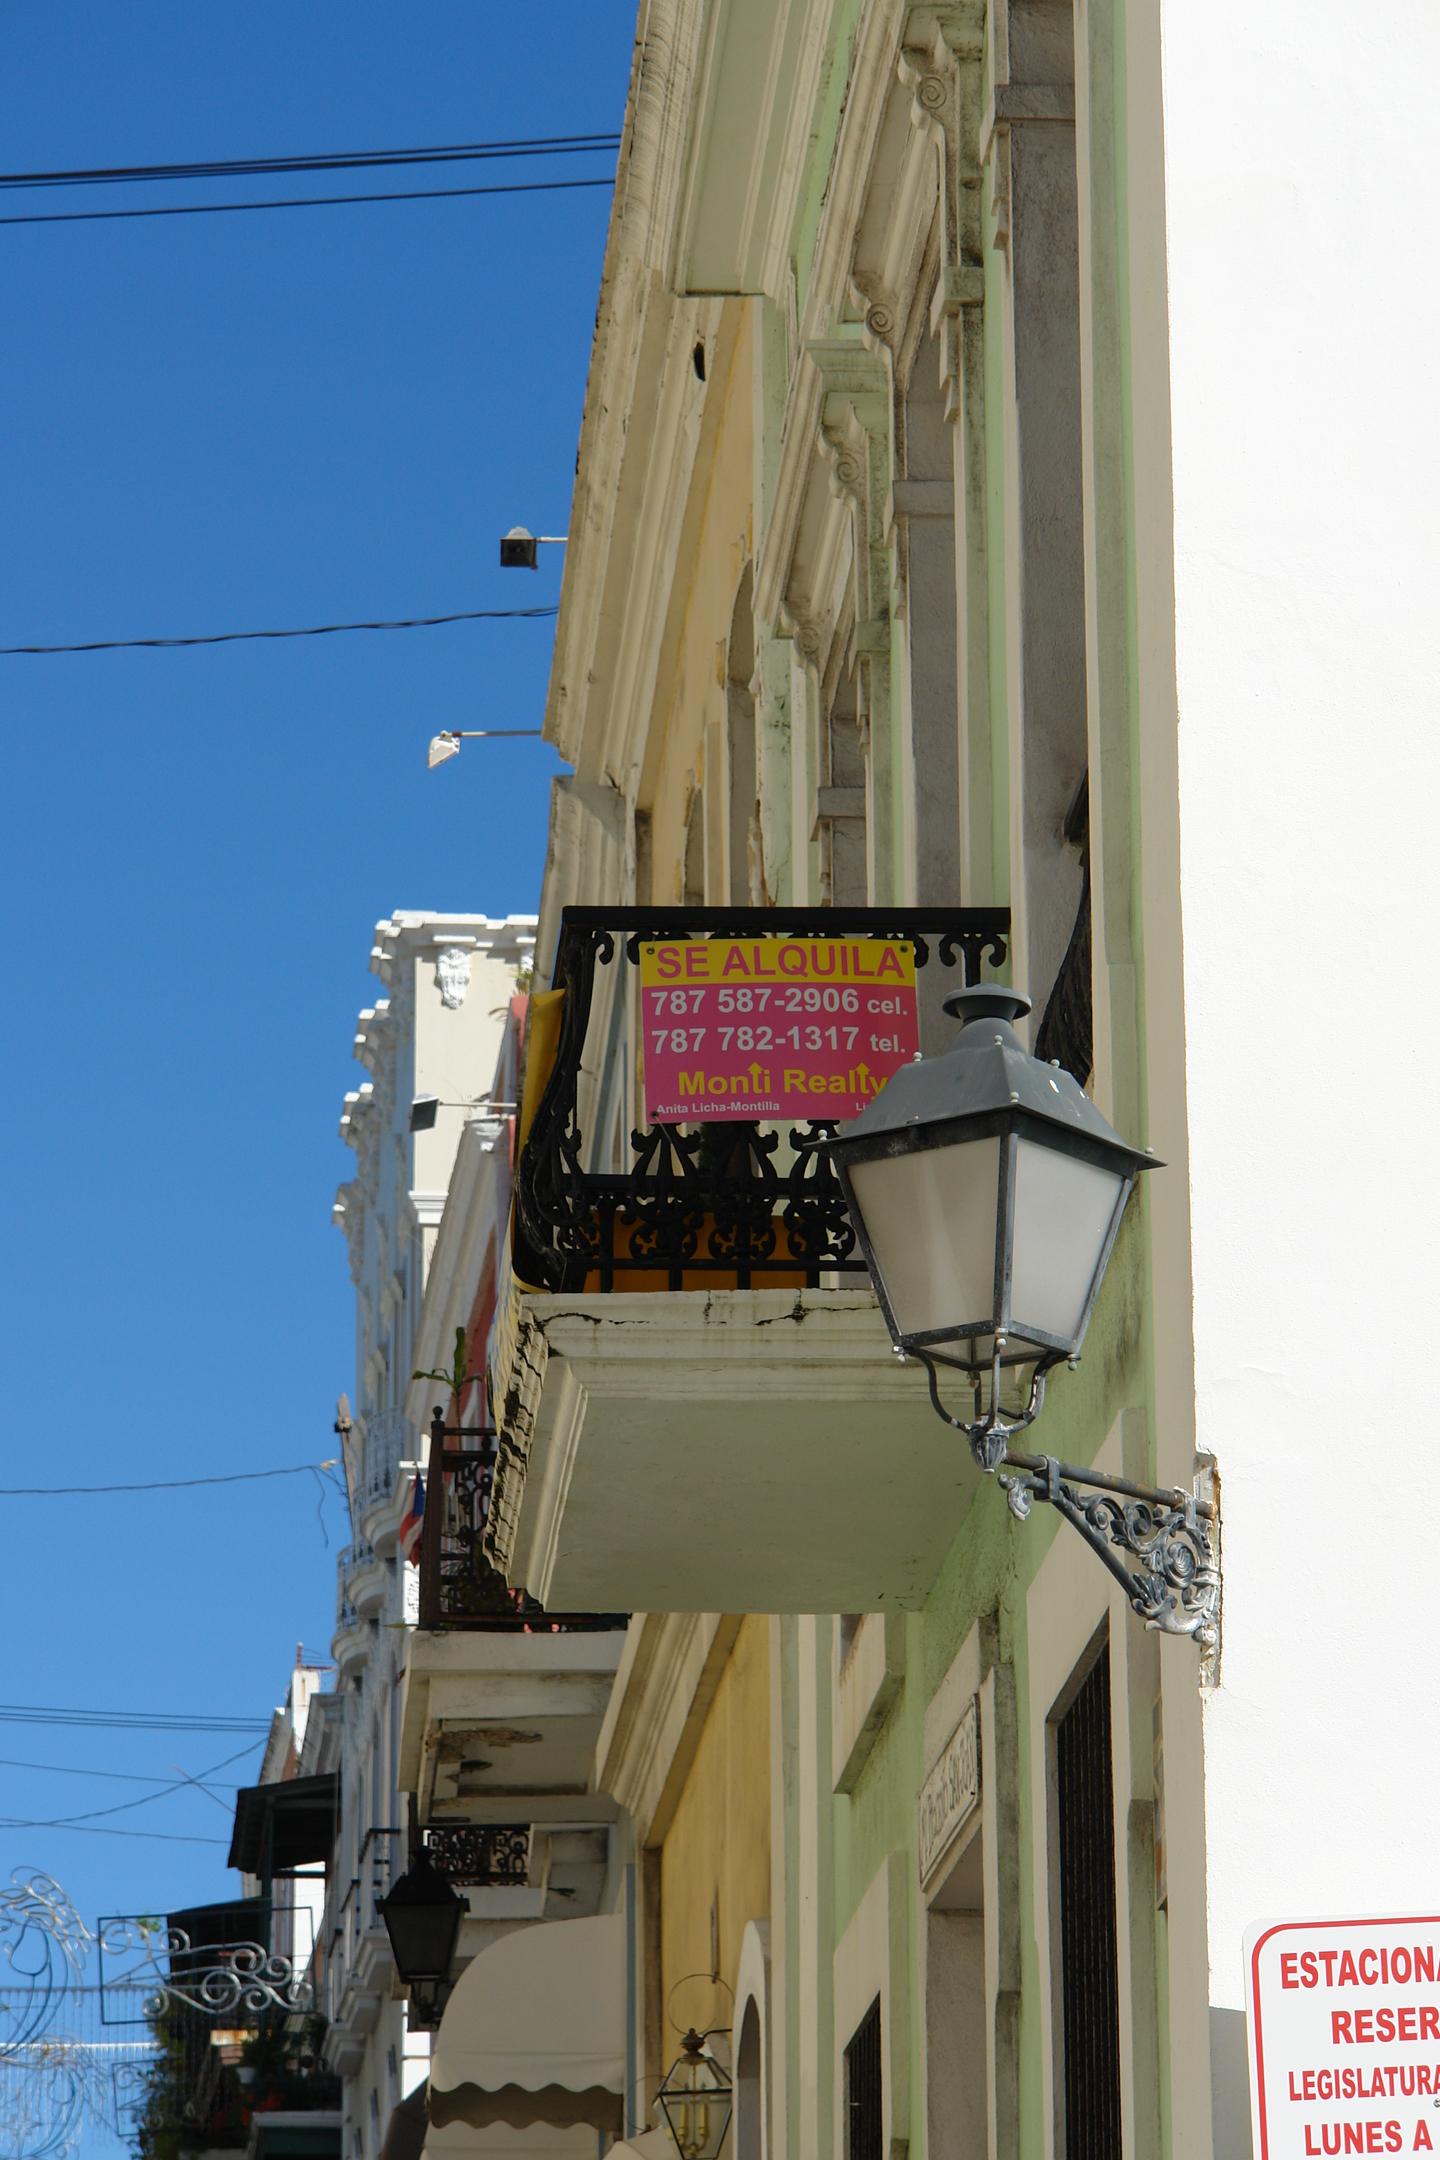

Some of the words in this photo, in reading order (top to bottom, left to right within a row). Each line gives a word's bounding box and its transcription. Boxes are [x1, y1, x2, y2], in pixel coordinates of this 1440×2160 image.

[656, 946, 709, 978] SE
[722, 944, 905, 979] ALQUILA
[651, 990, 706, 1016] 787
[718, 988, 859, 1014] 587-2906
[866, 997, 908, 1015] cel.
[651, 1028, 706, 1054] 787
[717, 1026, 859, 1051] 782-1317
[870, 1034, 906, 1053] tel.
[678, 1062, 771, 1096] Monti
[784, 1062, 888, 1100] Realty
[656, 1104, 688, 1114] Anita
[692, 1101, 780, 1113] Licha-Montilla
[1280, 1945, 1440, 1989] ESTACION
[1304, 2119, 1403, 2156] LUNES
[1412, 2119, 1434, 2151] A
